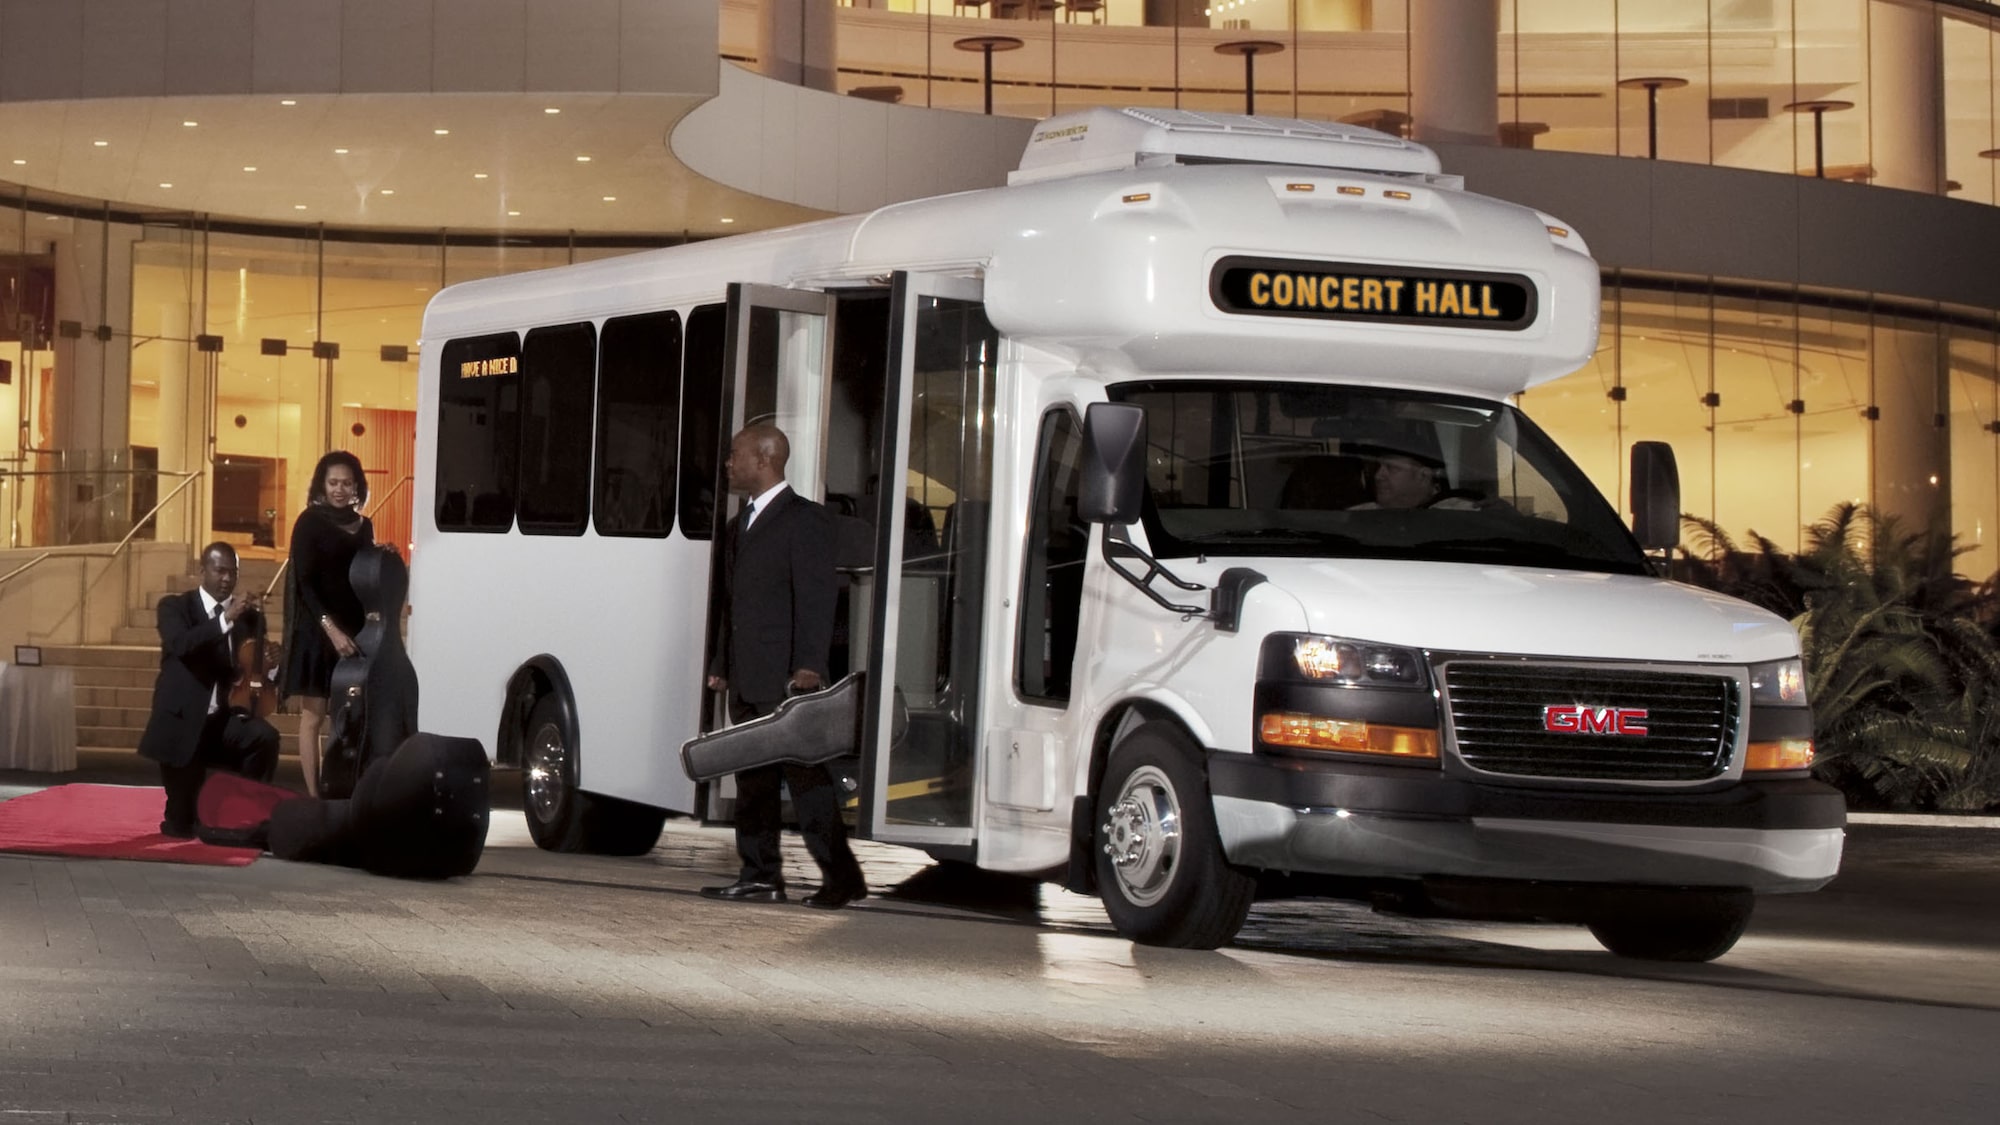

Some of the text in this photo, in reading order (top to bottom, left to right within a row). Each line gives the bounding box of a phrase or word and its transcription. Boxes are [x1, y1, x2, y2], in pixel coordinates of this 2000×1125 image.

[1250, 273, 1500, 316] CONCERT HALL
[481, 360, 488, 376] A
[489, 358, 508, 375] NICE
[1543, 705, 1648, 736] GMC
